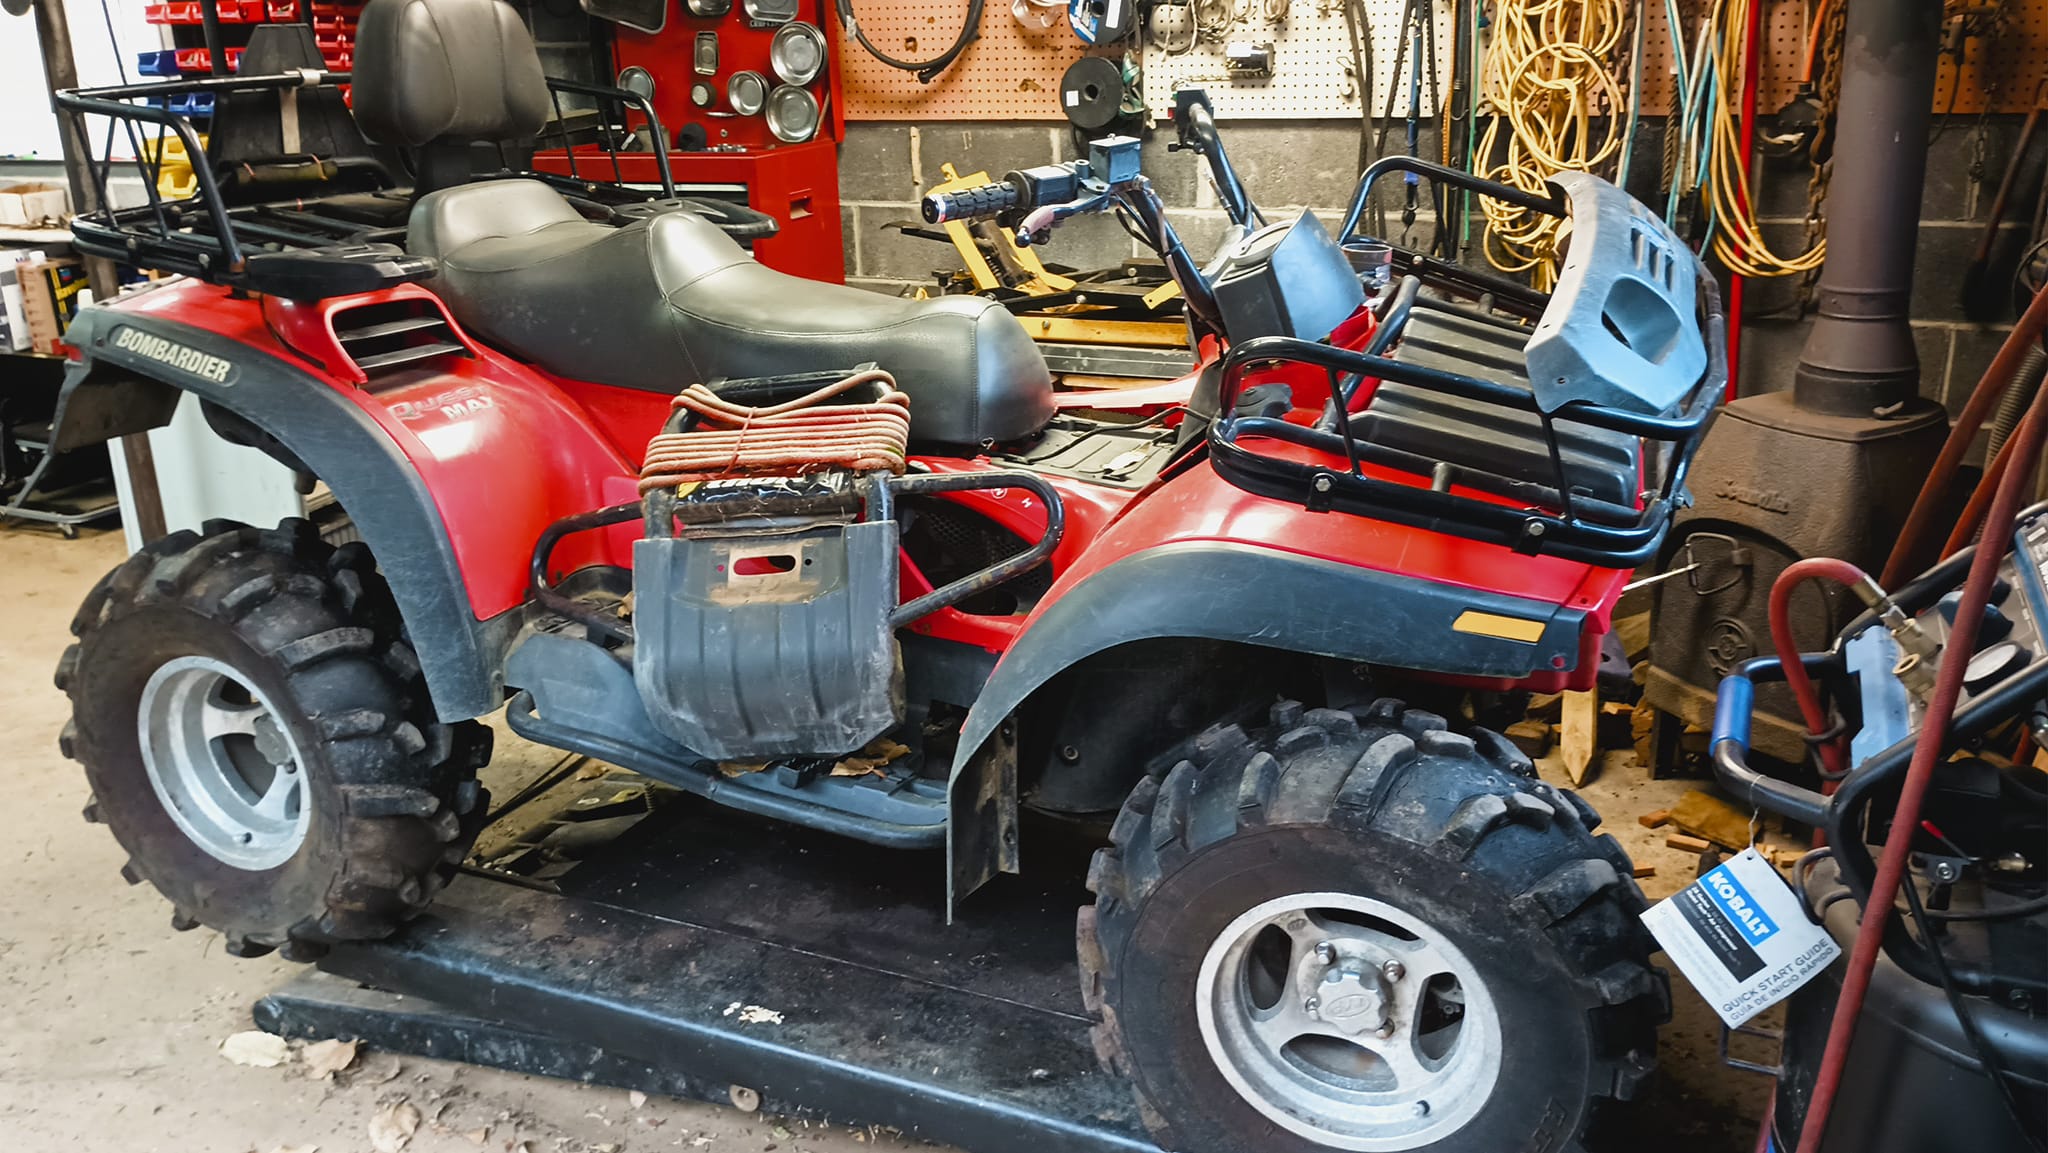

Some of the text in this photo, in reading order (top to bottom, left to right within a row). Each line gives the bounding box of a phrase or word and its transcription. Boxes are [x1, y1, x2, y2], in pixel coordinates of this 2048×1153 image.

[116, 327, 231, 382] BOMBARDIER
[440, 396, 494, 420] MAX
[1707, 871, 1770, 936] KOBALT
[1722, 937, 1829, 1013] QUICK START GUIDE
[1755, 994, 1769, 1006] DE
[1769, 973, 1800, 997] INICIO
